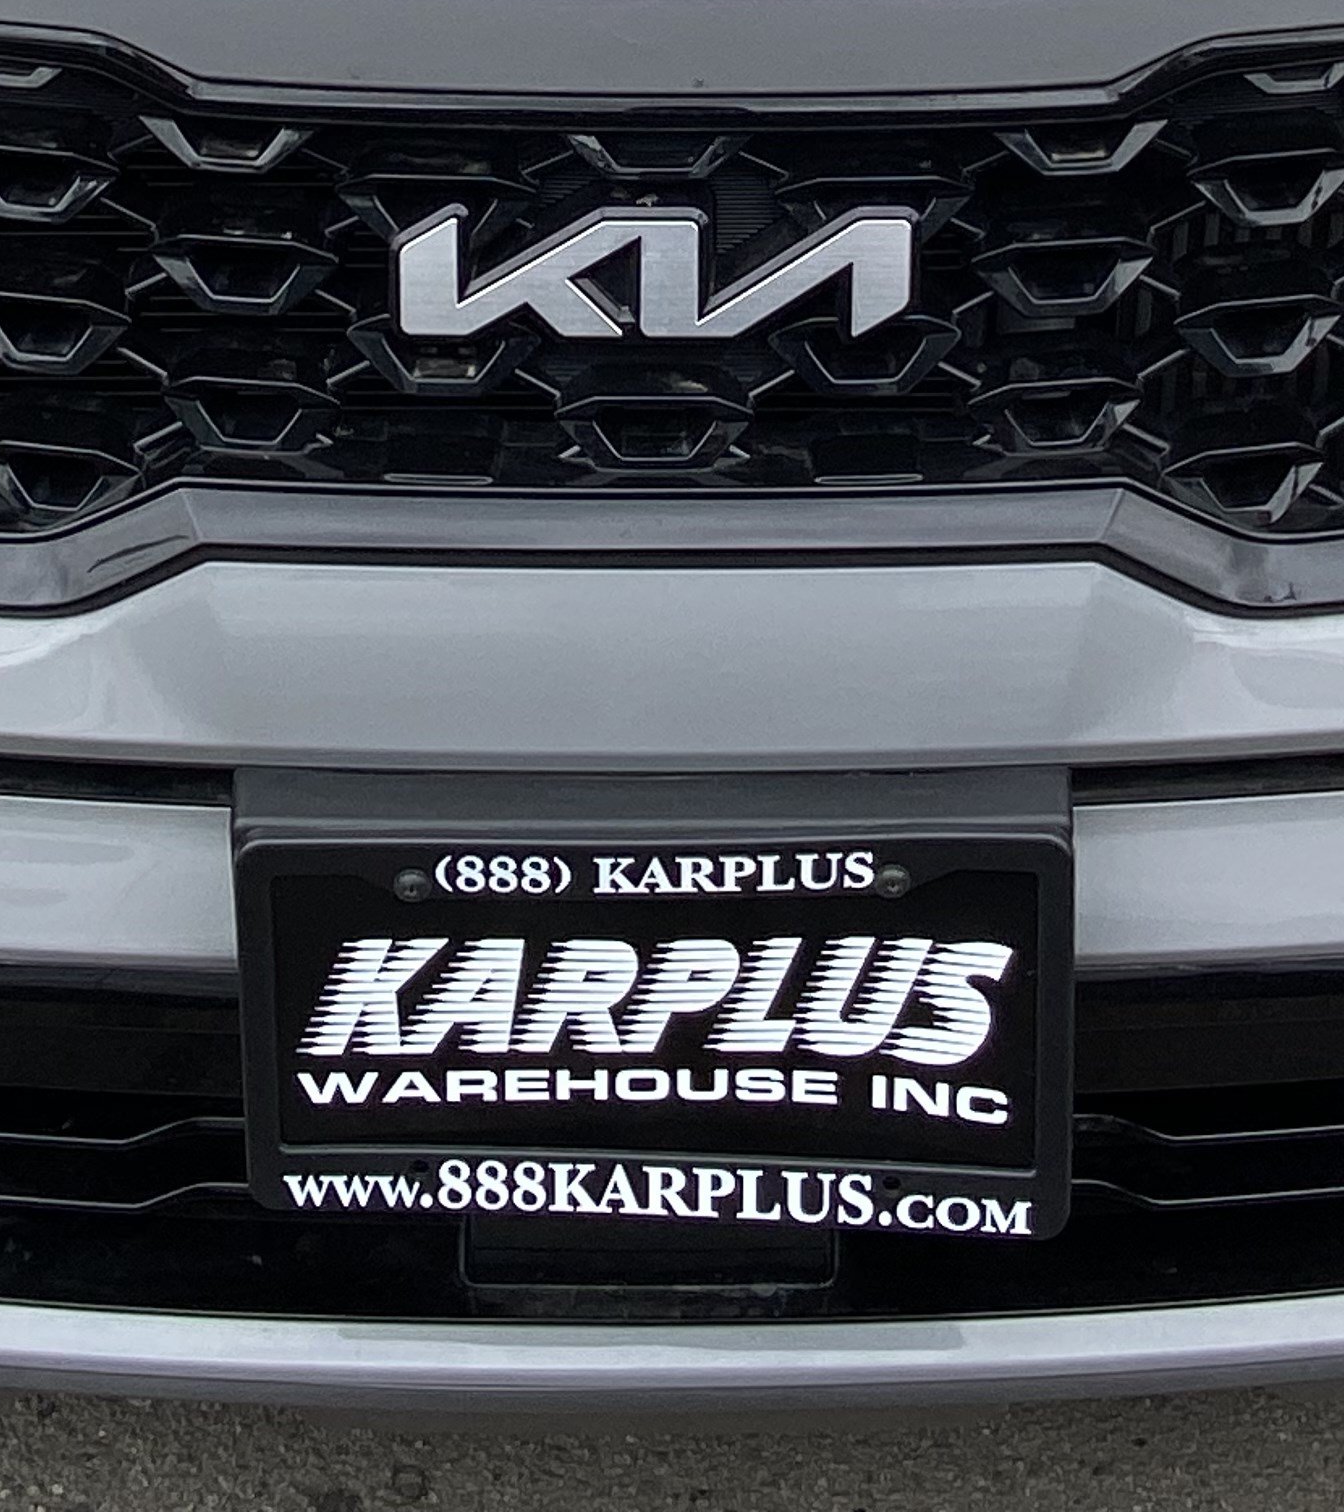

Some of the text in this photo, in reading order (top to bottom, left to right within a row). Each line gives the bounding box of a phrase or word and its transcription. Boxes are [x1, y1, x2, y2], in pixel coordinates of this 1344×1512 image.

[399, 216, 912, 337] KIA
[434, 850, 876, 895] (888) KARPLUS
[295, 935, 1015, 1066] KARPLUS
[296, 1067, 1009, 1126] WAREHOUSE INC
